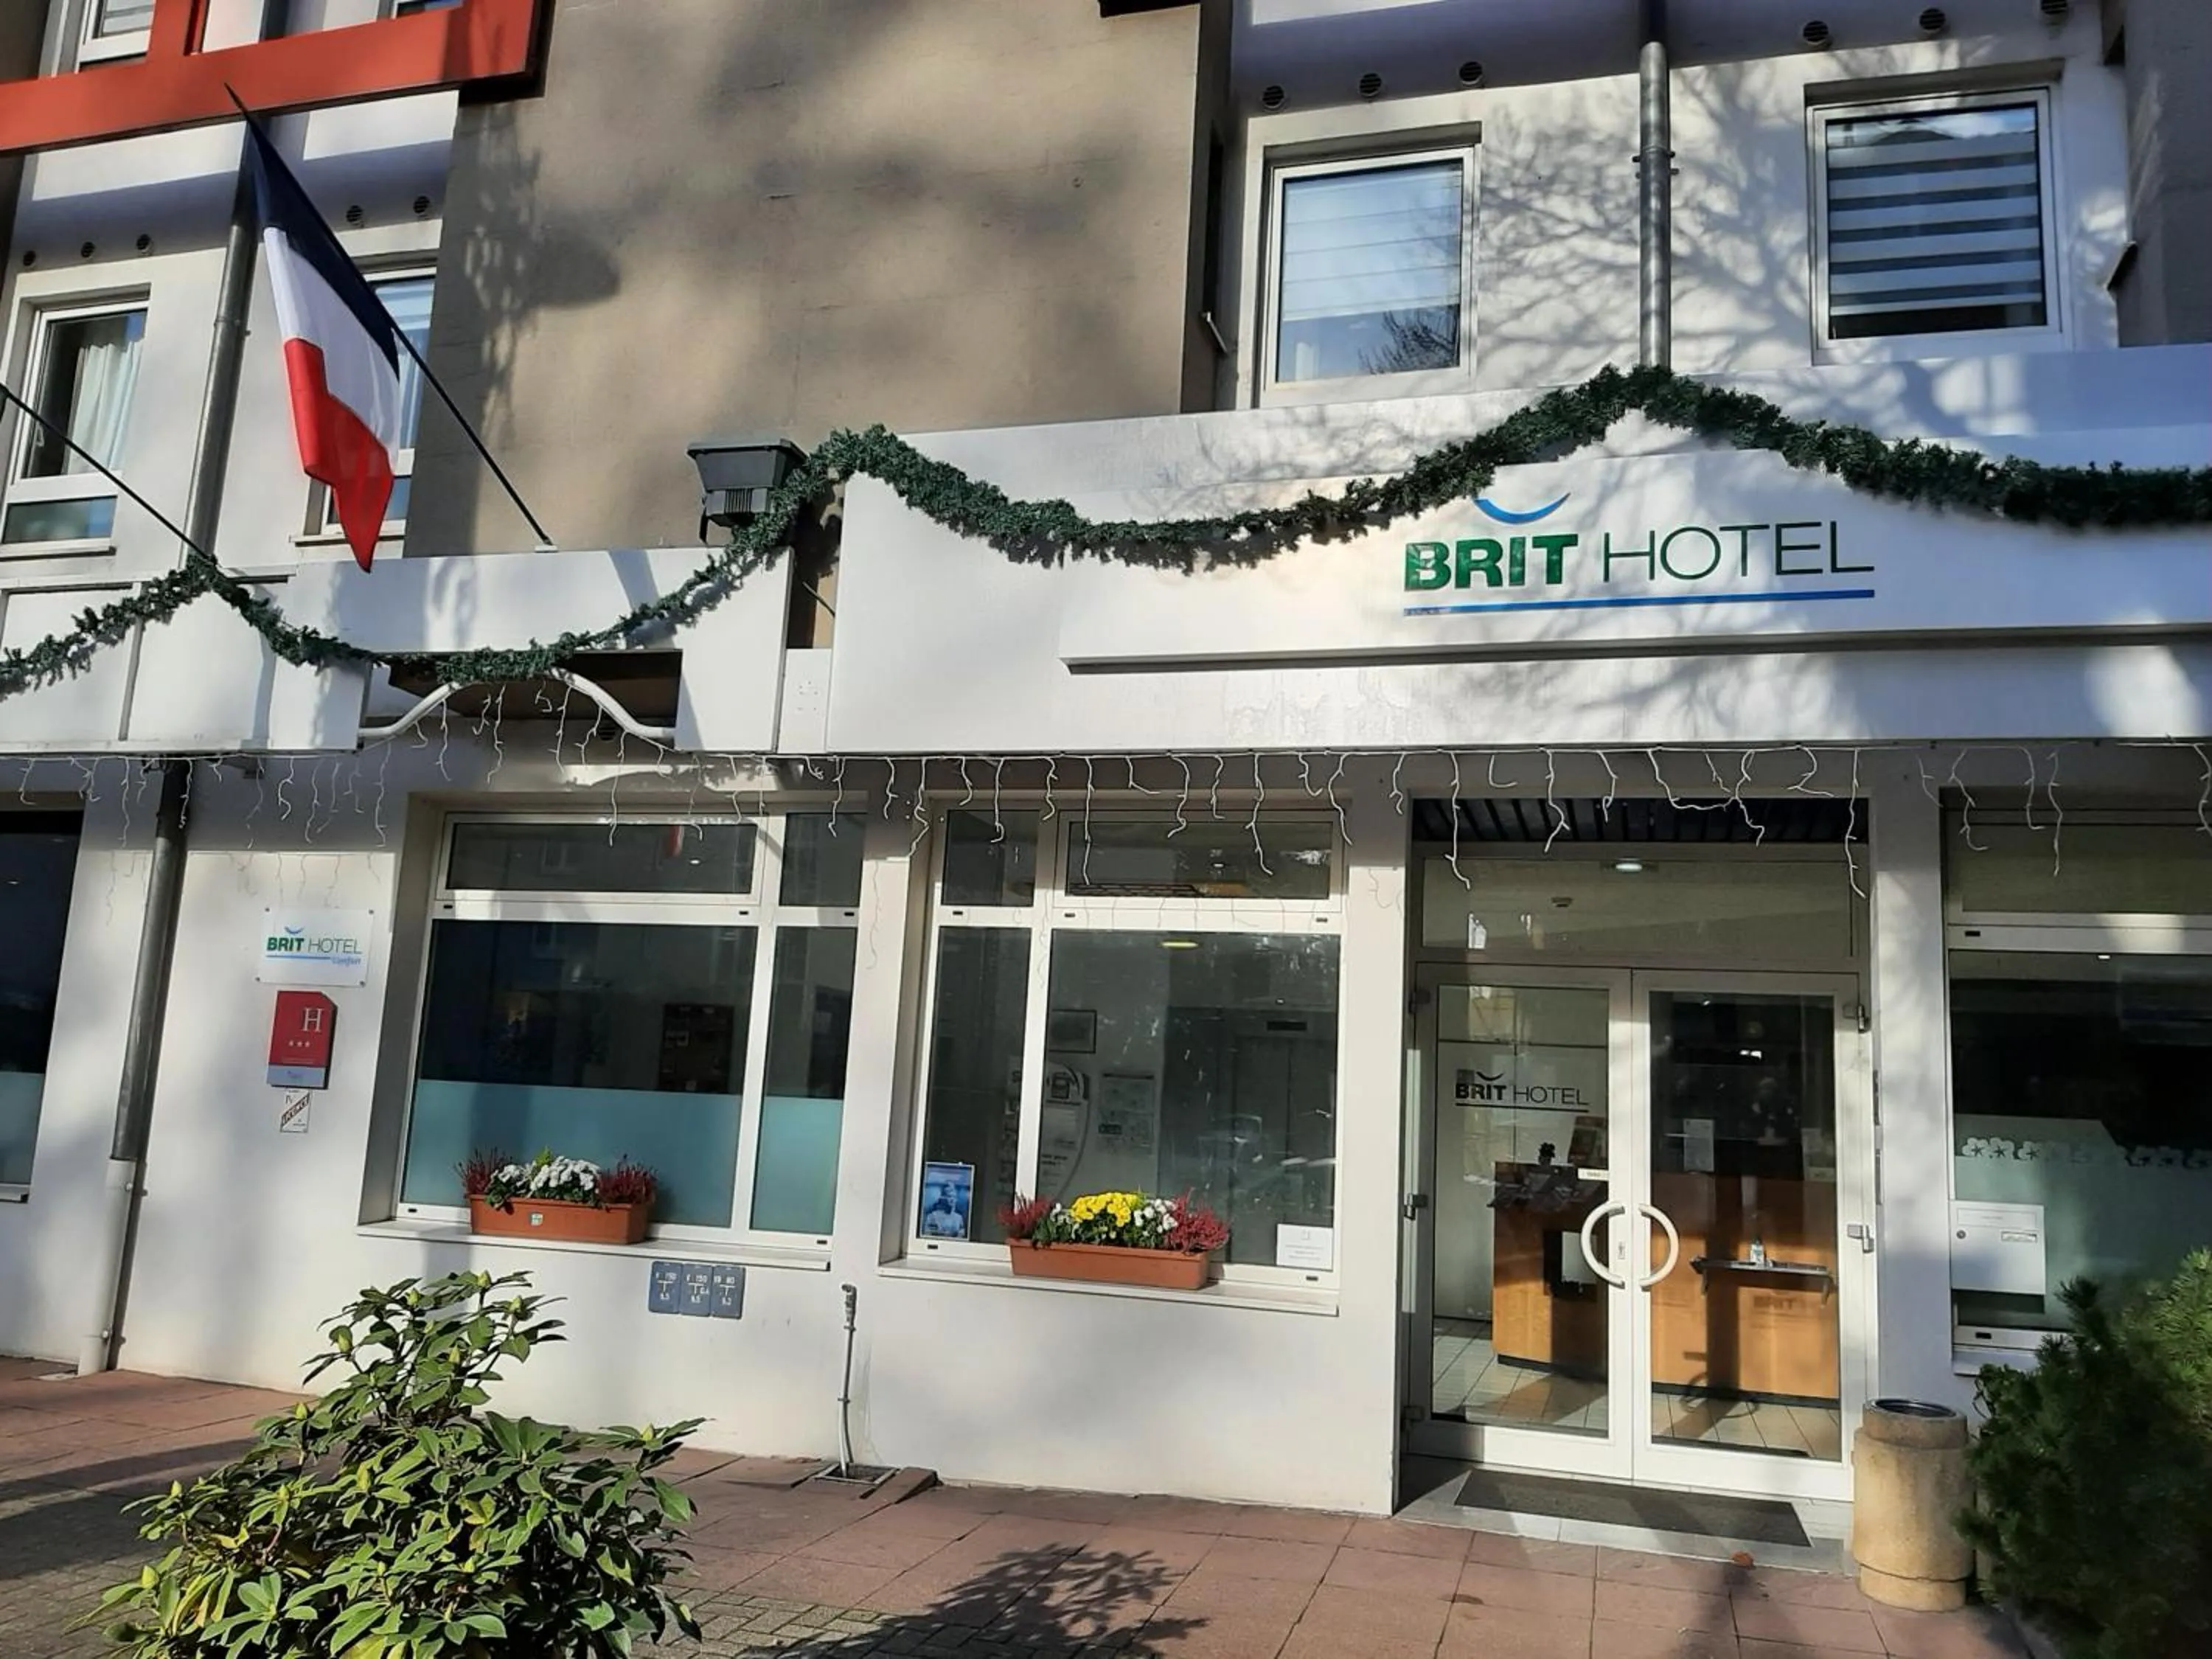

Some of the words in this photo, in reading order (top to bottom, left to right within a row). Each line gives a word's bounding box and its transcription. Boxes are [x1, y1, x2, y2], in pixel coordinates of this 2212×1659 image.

[1404, 533, 1579, 592] BRIT
[1602, 520, 1875, 582] HOTEL
[266, 937, 305, 952] BRIT
[308, 938, 363, 955] HOTEL
[301, 1007, 324, 1032] H
[1455, 1082, 1506, 1101] BRIT
[1513, 1085, 1589, 1106] HOTEL
